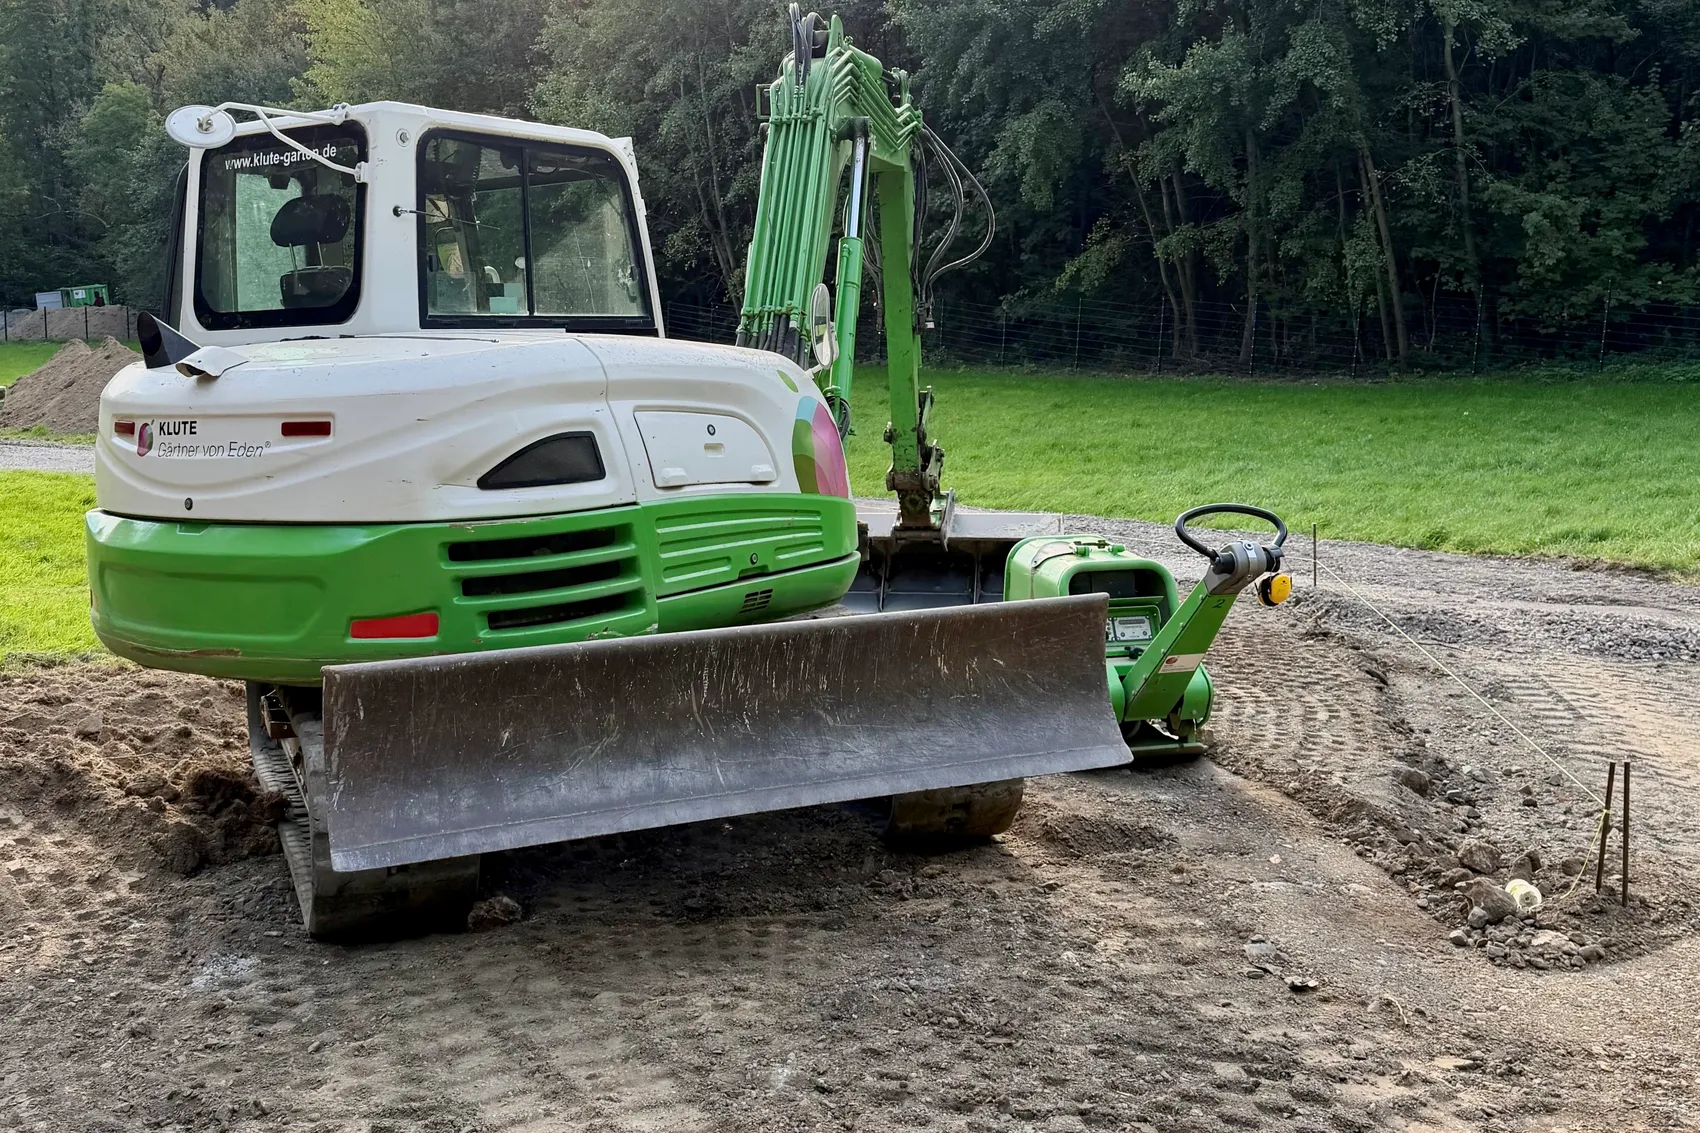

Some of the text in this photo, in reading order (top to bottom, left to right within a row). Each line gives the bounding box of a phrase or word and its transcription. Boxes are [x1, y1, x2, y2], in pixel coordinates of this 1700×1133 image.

[159, 420, 197, 436] KLUTE
[157, 442, 200, 458] Gärtner
[202, 444, 225, 458] von
[1212, 599, 1225, 609] 2
